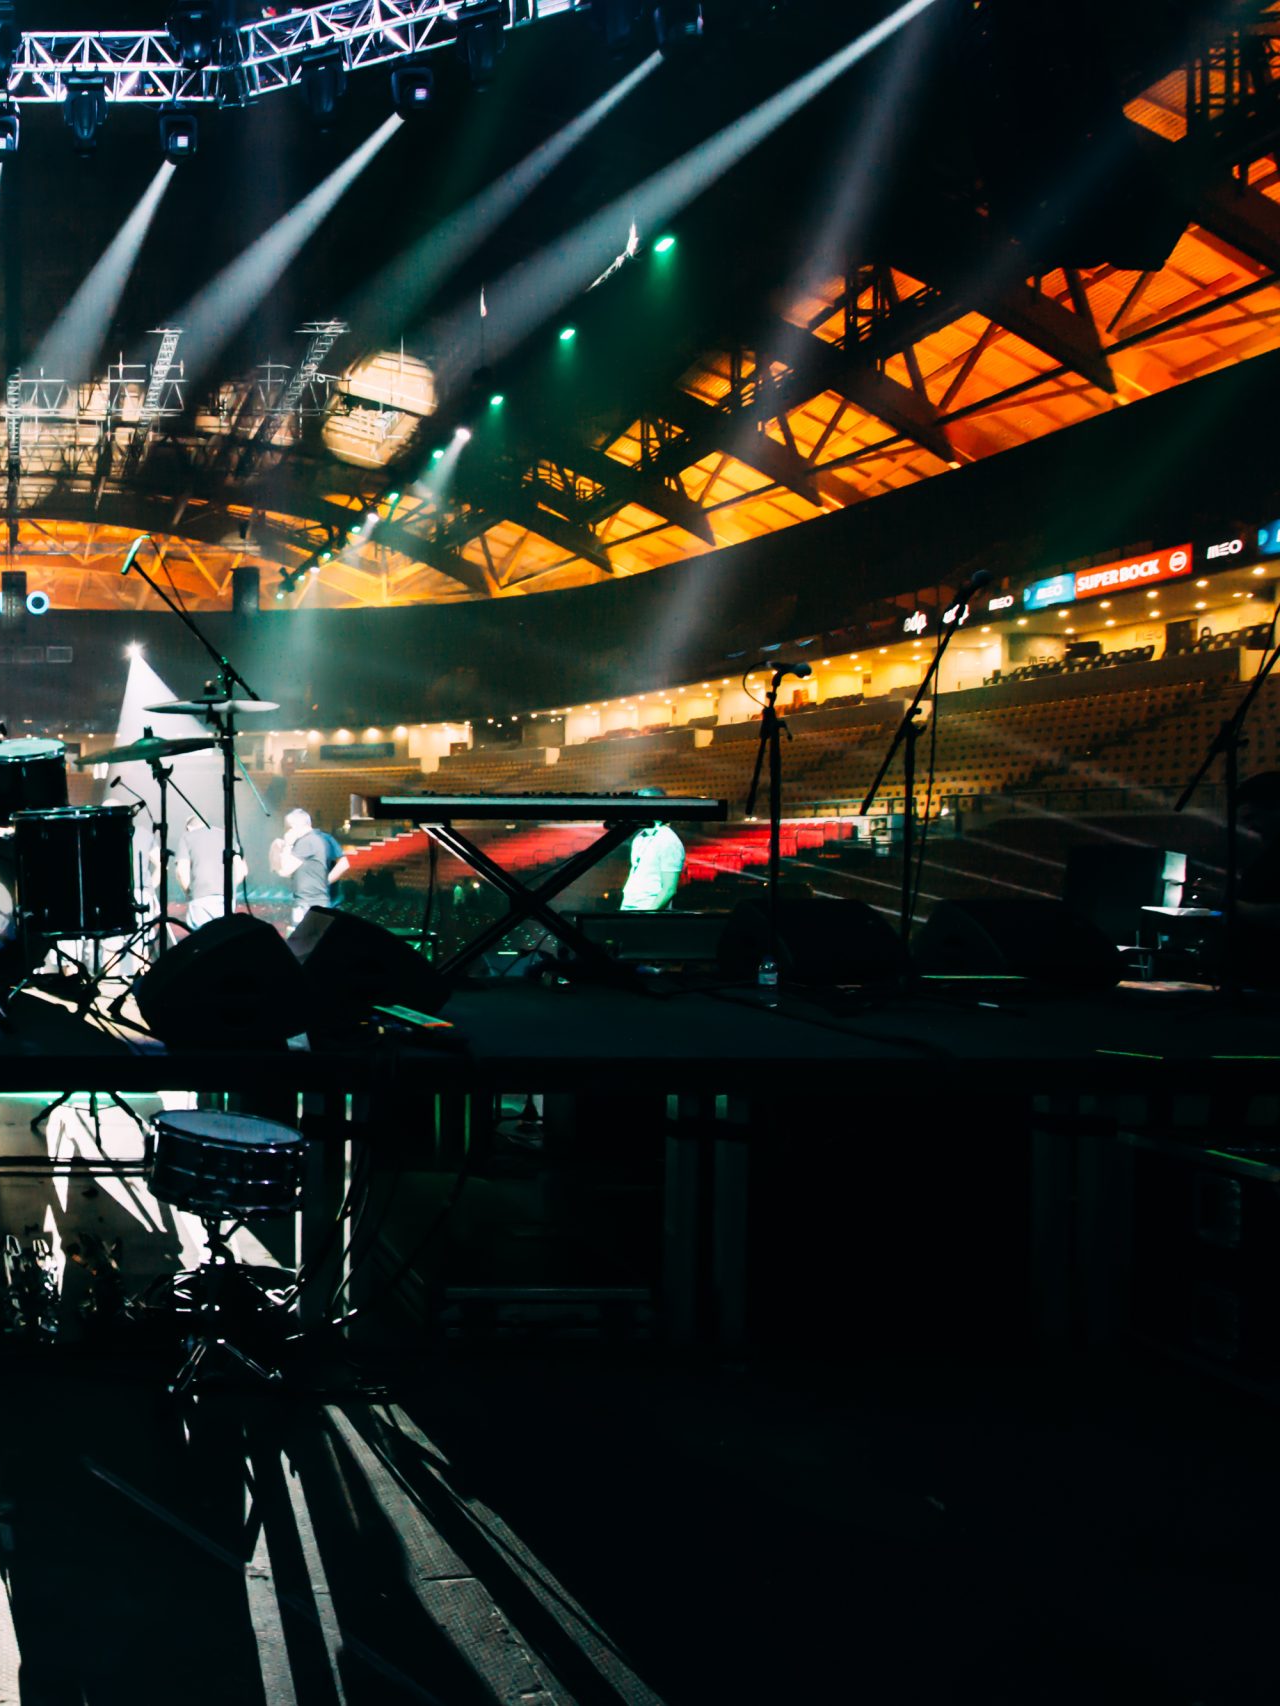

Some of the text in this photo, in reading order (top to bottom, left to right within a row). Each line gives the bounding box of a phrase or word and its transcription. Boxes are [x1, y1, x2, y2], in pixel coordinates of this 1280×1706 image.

[1206, 539, 1243, 560] MEO
[1076, 558, 1160, 593] SUPER BOCK
[1035, 583, 1063, 600] MEO
[988, 595, 1014, 611] MEO
